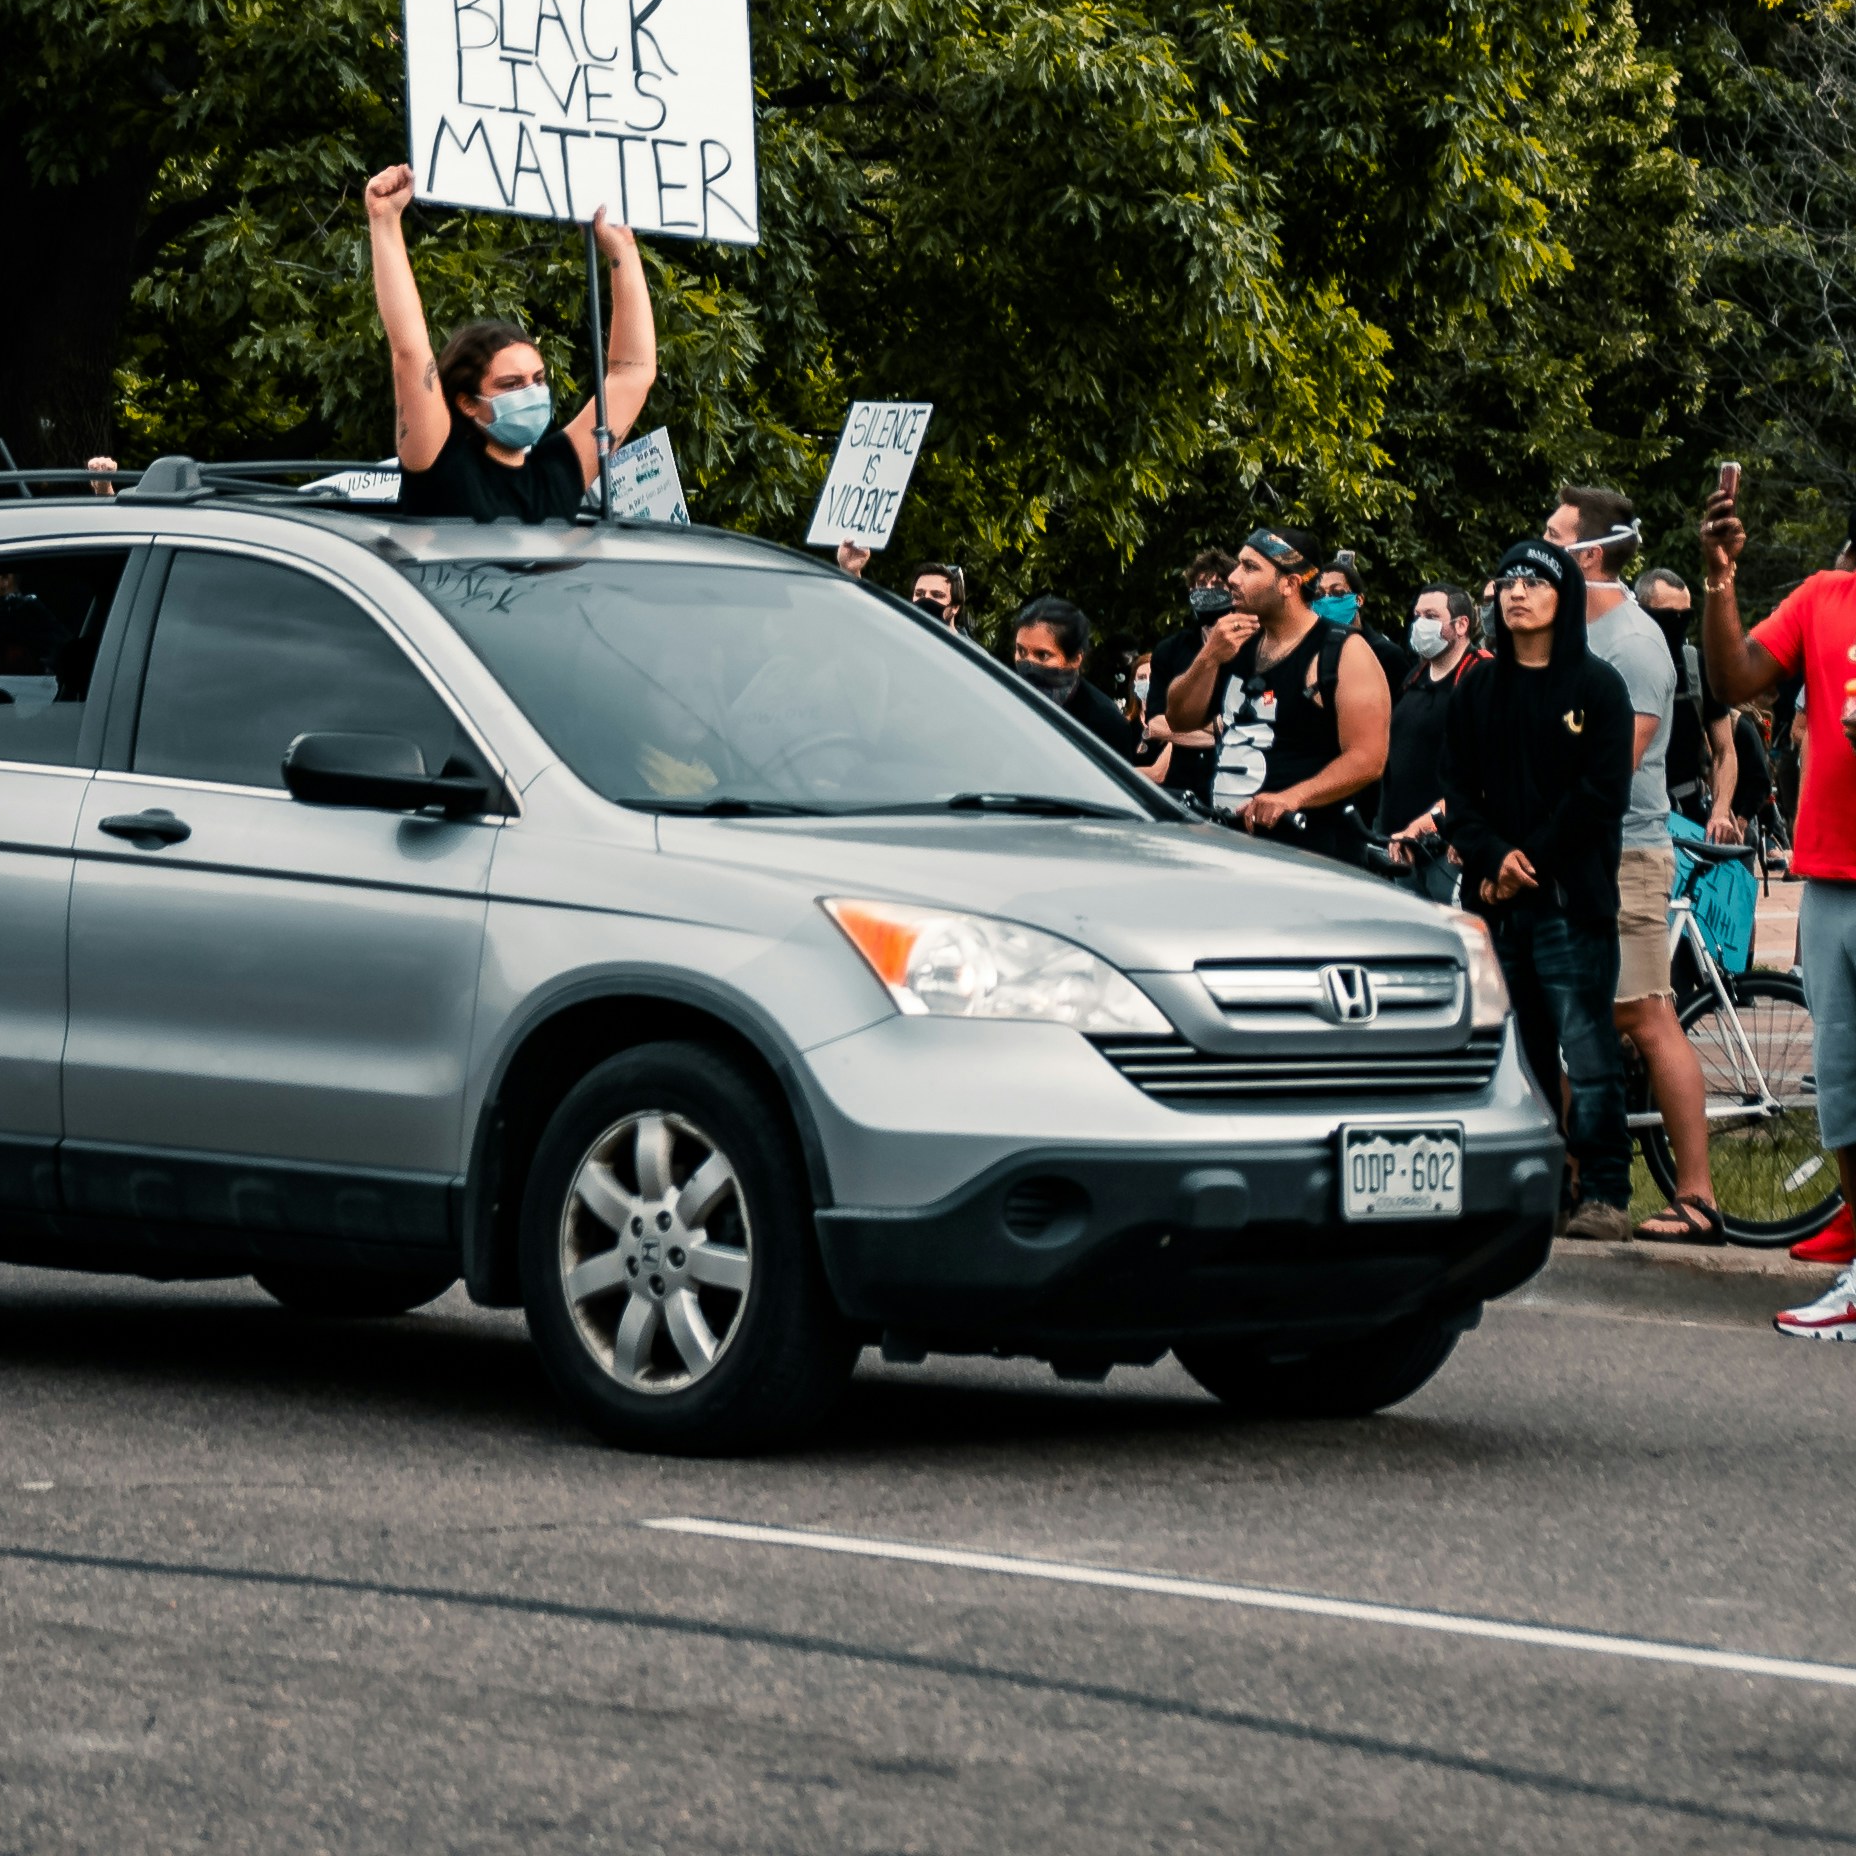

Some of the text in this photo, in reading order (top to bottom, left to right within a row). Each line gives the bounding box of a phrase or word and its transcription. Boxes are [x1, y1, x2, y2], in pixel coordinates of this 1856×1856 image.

[457, 48, 667, 132] LIVES
[426, 114, 757, 238] MATTER
[850, 405, 927, 455] SILENCE
[862, 453, 881, 485] IS
[827, 483, 899, 535] VIOLENCE
